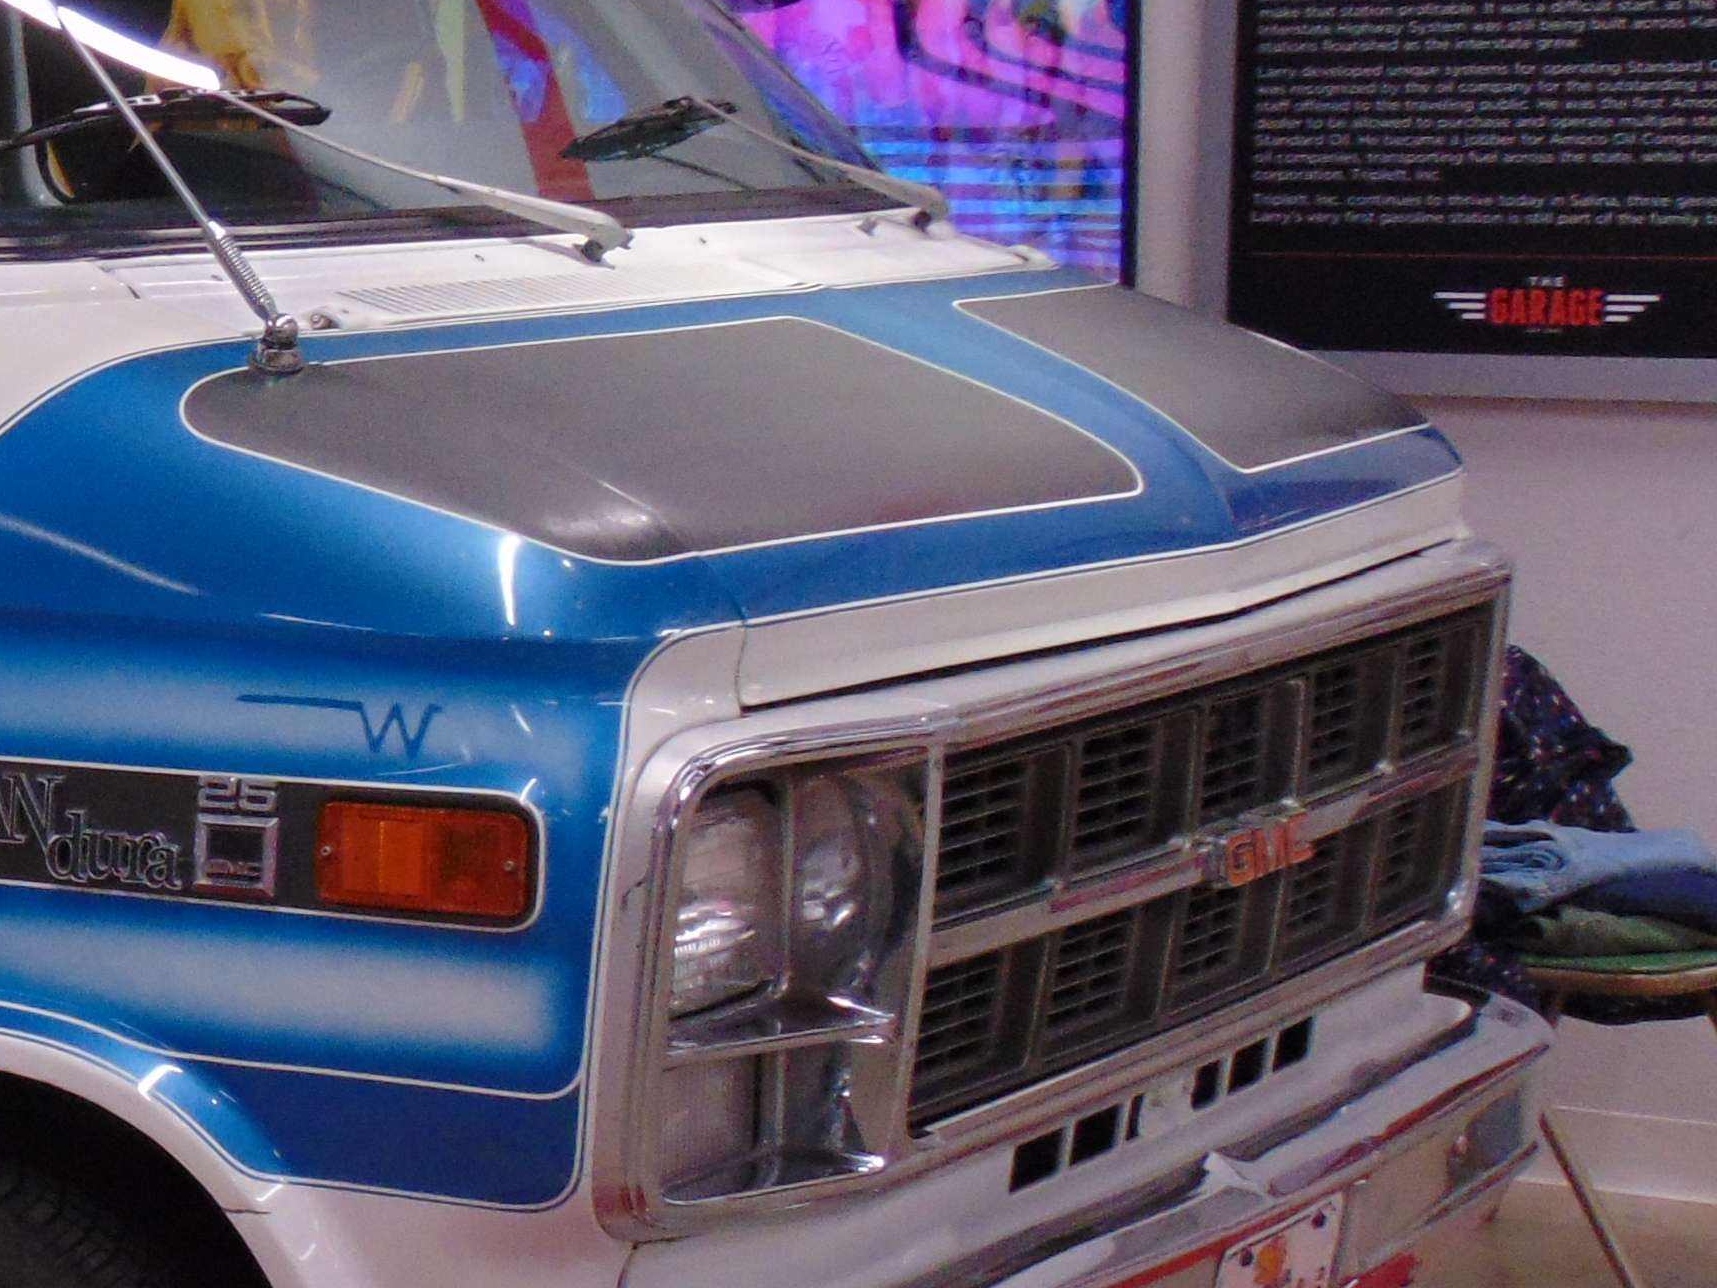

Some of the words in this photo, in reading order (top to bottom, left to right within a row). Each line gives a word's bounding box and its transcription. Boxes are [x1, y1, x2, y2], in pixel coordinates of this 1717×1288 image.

[1528, 275, 1564, 287] THE
[1490, 288, 1604, 326] GARAGE
[197, 774, 278, 813] 25
[1224, 813, 1315, 888] GMC
